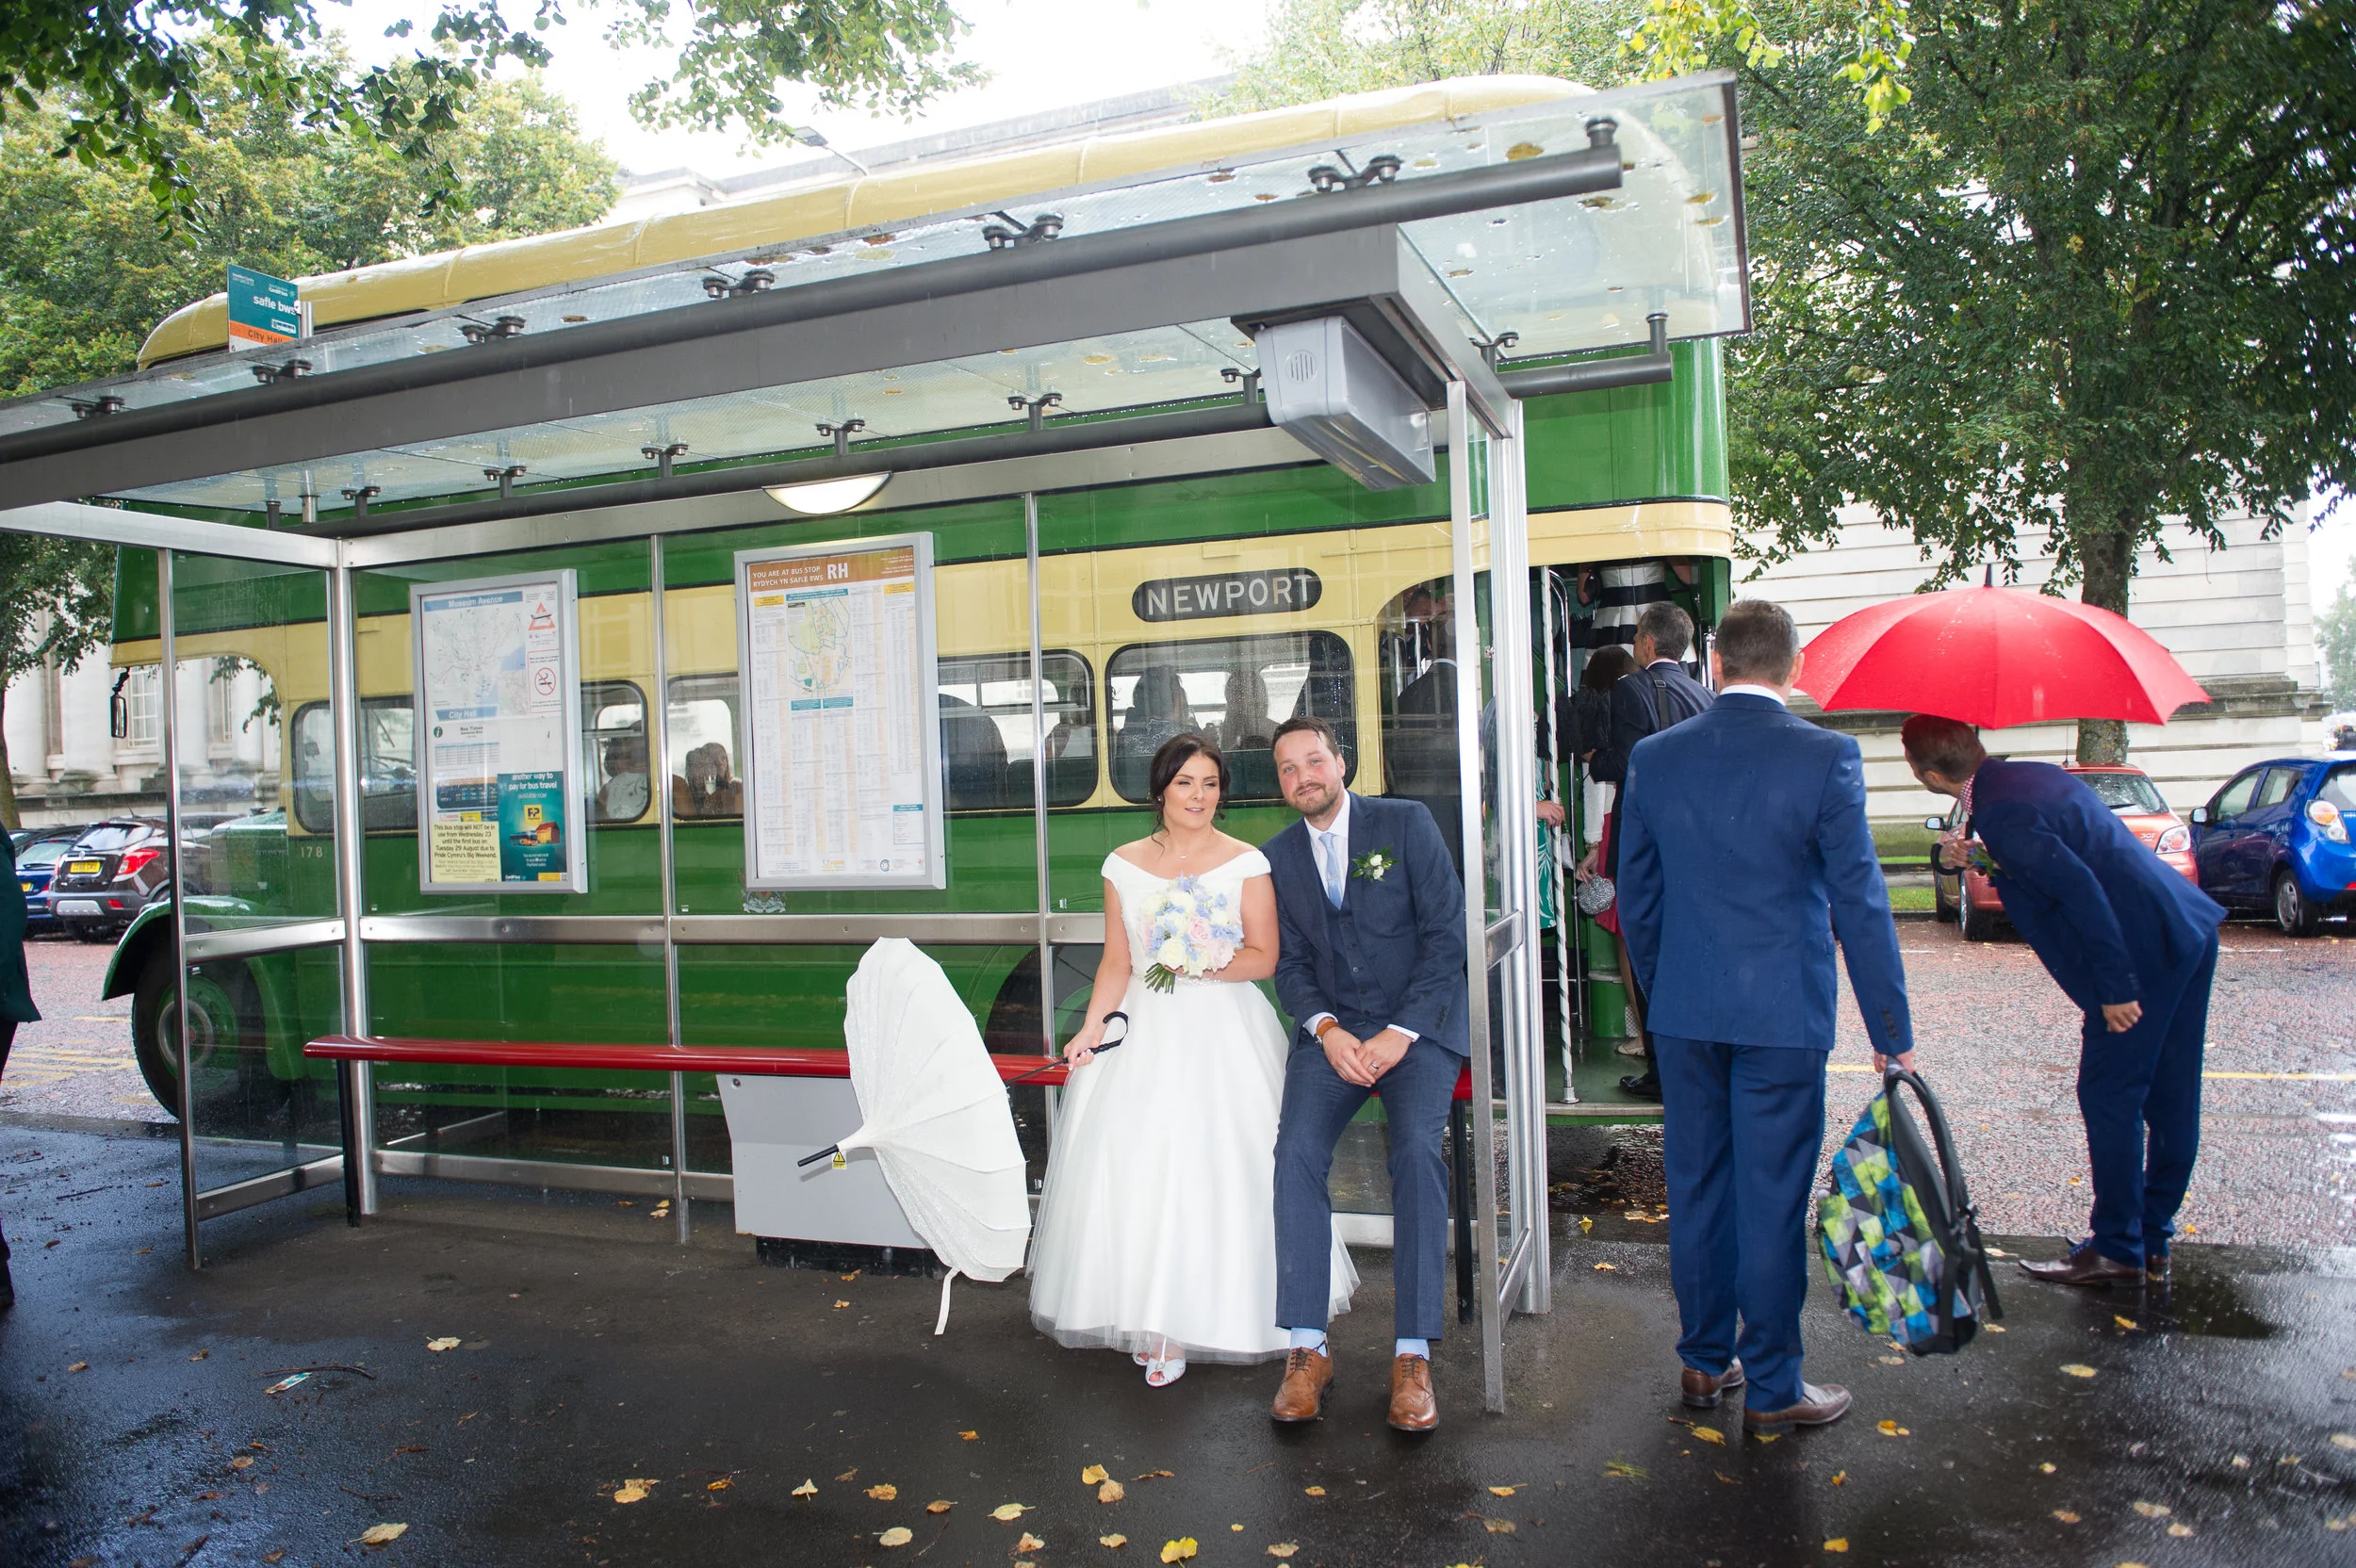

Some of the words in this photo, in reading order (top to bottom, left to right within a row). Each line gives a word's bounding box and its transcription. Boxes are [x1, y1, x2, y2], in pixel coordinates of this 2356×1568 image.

[253, 295, 277, 310] safle
[278, 301, 297, 316] bws
[248, 329, 265, 342] City
[804, 565, 821, 574] STOP
[826, 562, 848, 580] RH
[753, 578, 778, 588] RYDYCH
[778, 577, 789, 585] YN
[790, 576, 809, 584] SAFLE
[810, 574, 824, 582] BWS
[1147, 575, 1313, 615] NEWPORT
[448, 599, 477, 609] Museum
[478, 596, 503, 605] Avenue
[449, 710, 463, 720] City
[301, 846, 323, 858] 178
